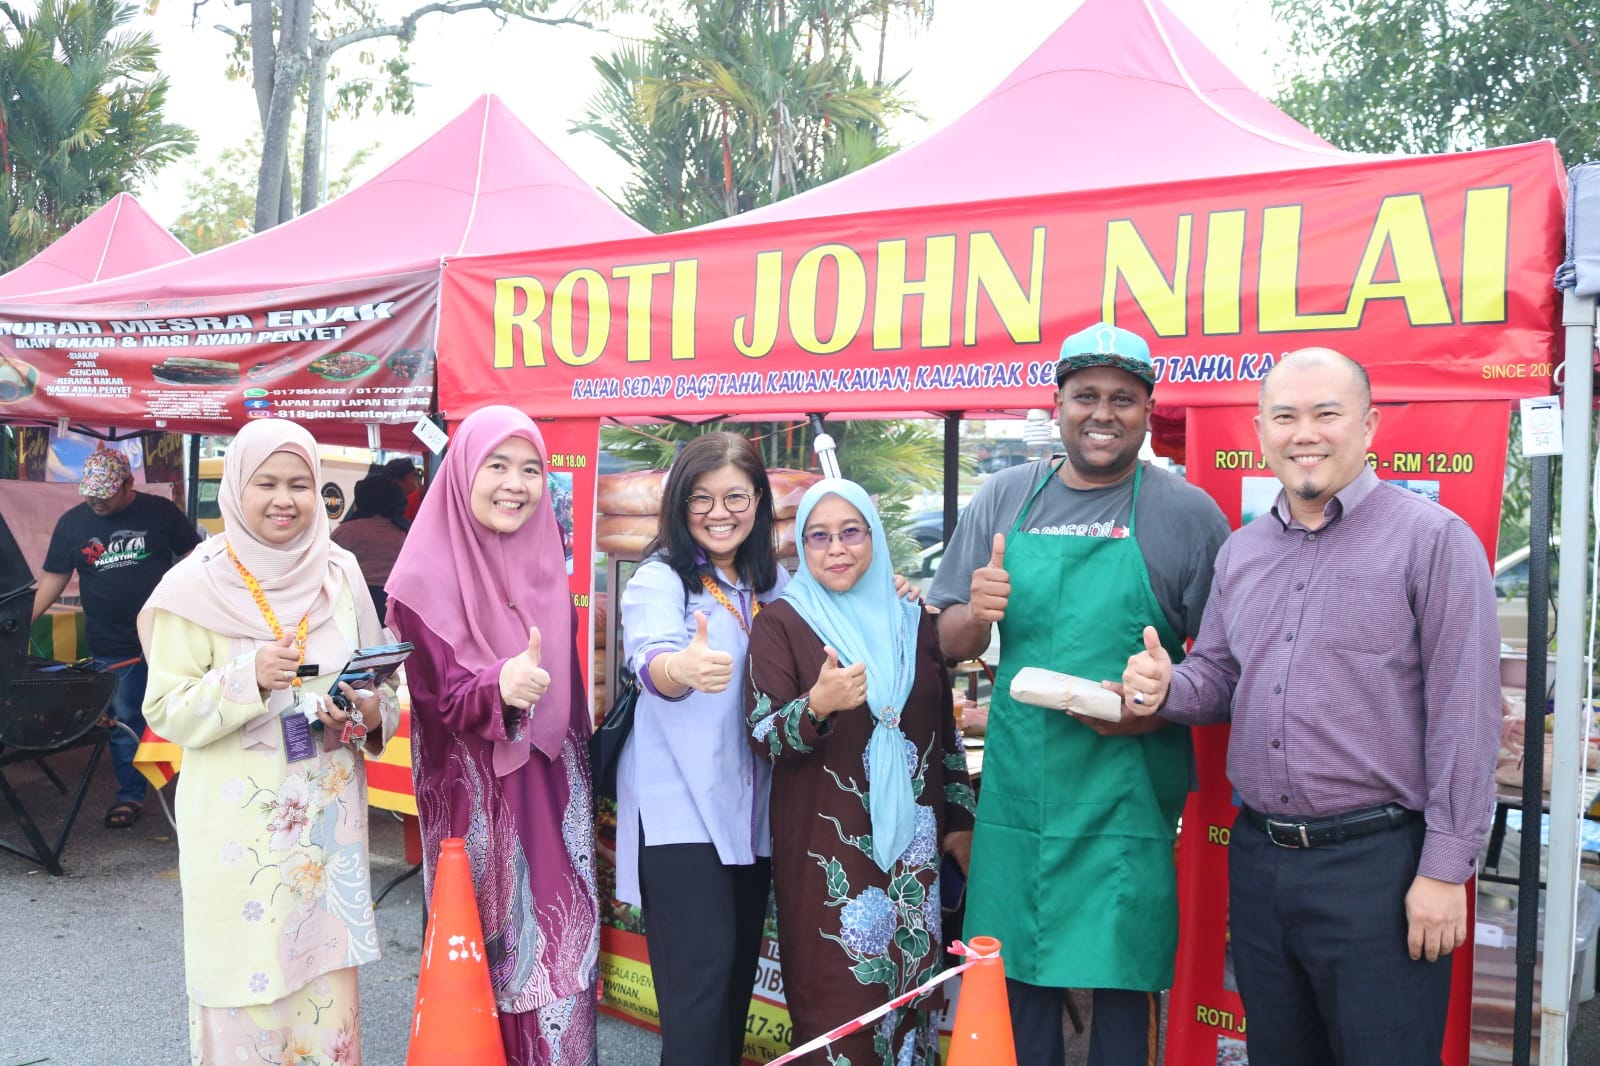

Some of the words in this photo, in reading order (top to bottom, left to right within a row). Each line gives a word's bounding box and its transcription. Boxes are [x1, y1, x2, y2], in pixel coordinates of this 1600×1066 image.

[492, 258, 699, 369] ROTI
[732, 225, 1047, 359] JOHN
[1101, 184, 1512, 338] NILAI
[109, 313, 253, 334] MESRA
[266, 301, 395, 328] ENAK
[15, 337, 51, 349] IKAN
[55, 336, 116, 349] BAKAR
[121, 336, 138, 348] &
[143, 334, 188, 348] NASI
[195, 332, 250, 346] AYAM
[257, 326, 346, 343] PENYET
[1482, 363, 1526, 379] SINCE
[72, 386, 97, 394] AYAM
[99, 386, 132, 394] PENYET
[93, 377, 123, 385] BAKAR
[572, 379, 619, 400] KALAU
[622, 375, 672, 398] SEDAP
[765, 365, 911, 395] KAWAN-KAWAN,
[313, 399, 340, 407] SATU
[342, 398, 381, 407] LAPAN
[1535, 435, 1550, 447] 54
[551, 454, 564, 468] RM
[565, 454, 586, 468] 18.00
[1215, 450, 1254, 469] ROTI
[1393, 452, 1422, 473] RM
[1426, 452, 1474, 474] 12.00
[571, 593, 589, 608] 6.00
[1208, 824, 1231, 847] RO
[1196, 1004, 1234, 1031] ROTI
